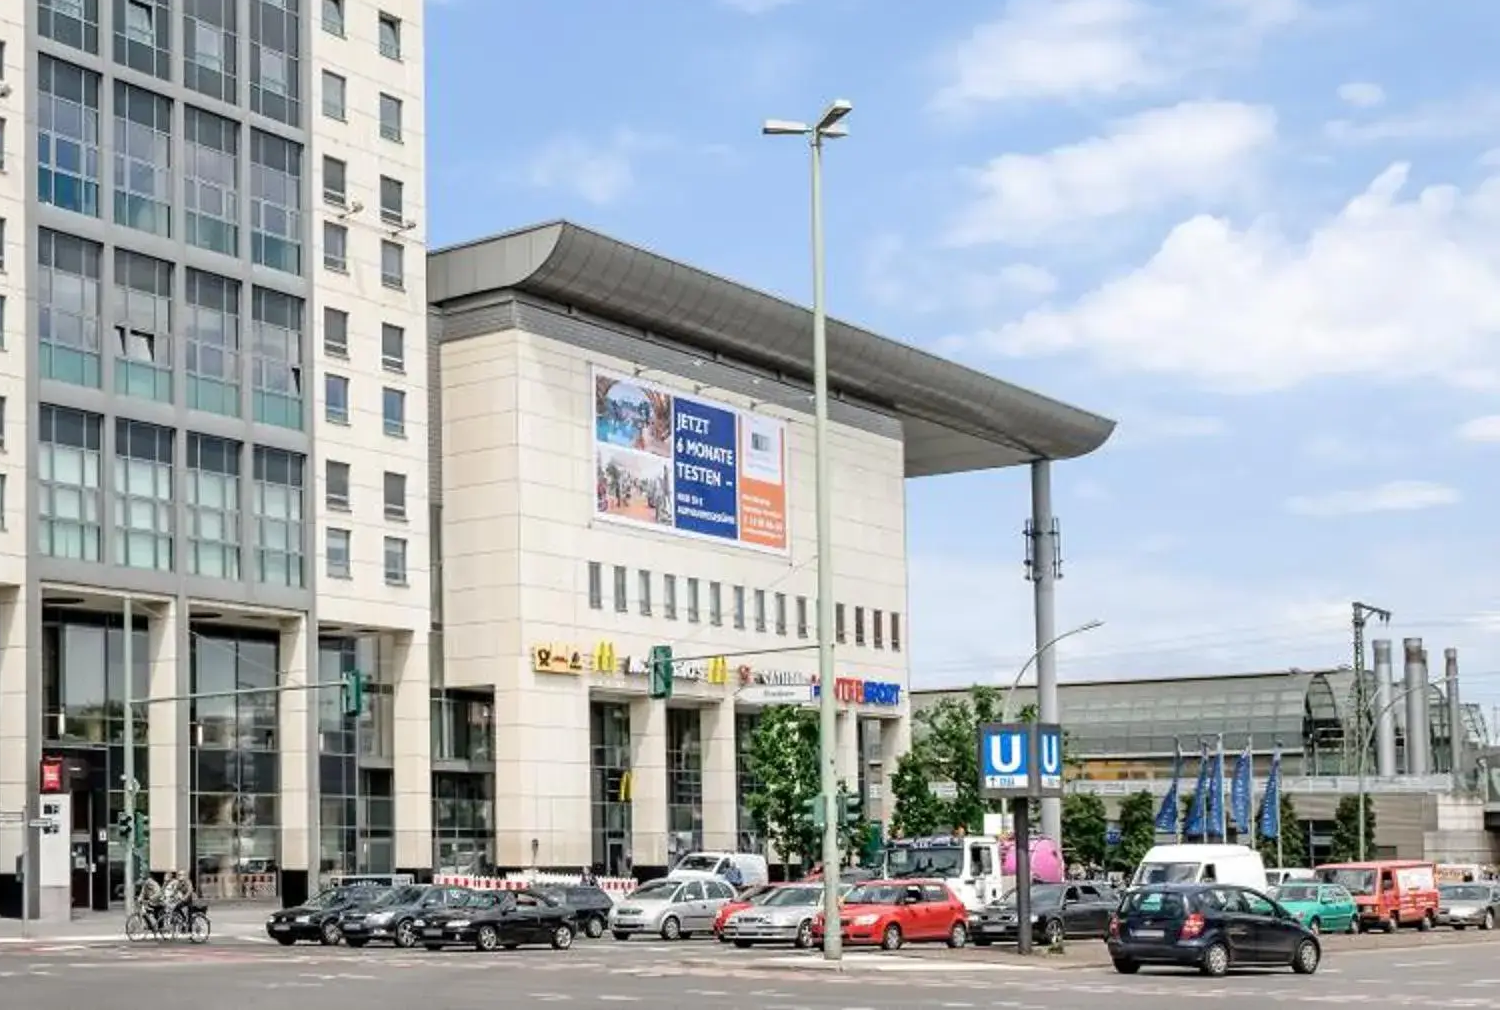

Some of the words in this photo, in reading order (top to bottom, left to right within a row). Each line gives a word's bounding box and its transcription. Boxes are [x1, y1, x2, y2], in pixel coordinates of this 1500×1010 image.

[676, 413, 710, 435] JETZT
[686, 438, 733, 465] MONATE
[676, 461, 722, 487] TESTEN
[991, 734, 1021, 773] U
[1042, 734, 1058, 773] U
